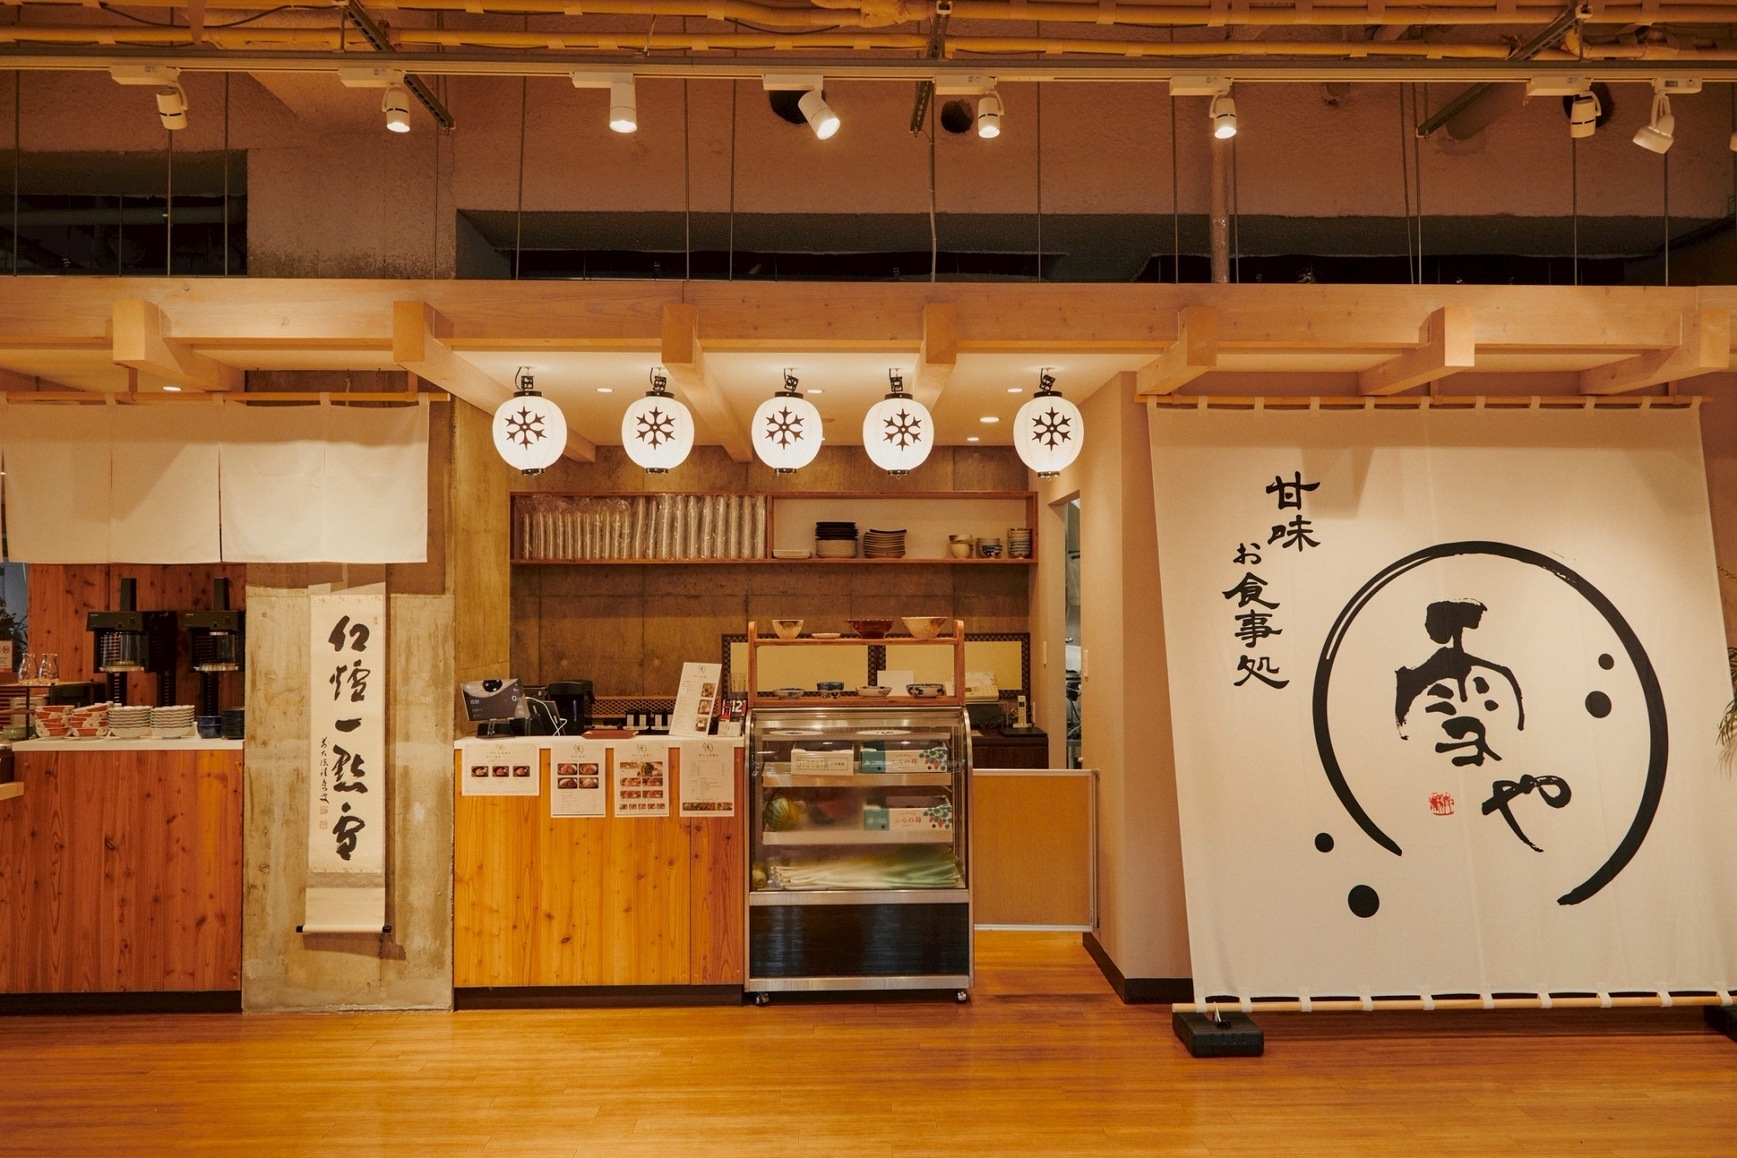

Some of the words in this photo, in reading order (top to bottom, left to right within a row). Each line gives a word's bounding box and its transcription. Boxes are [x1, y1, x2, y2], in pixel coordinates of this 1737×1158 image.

[1265, 471, 1321, 552] 甘味
[1222, 543, 1290, 690] お食事処
